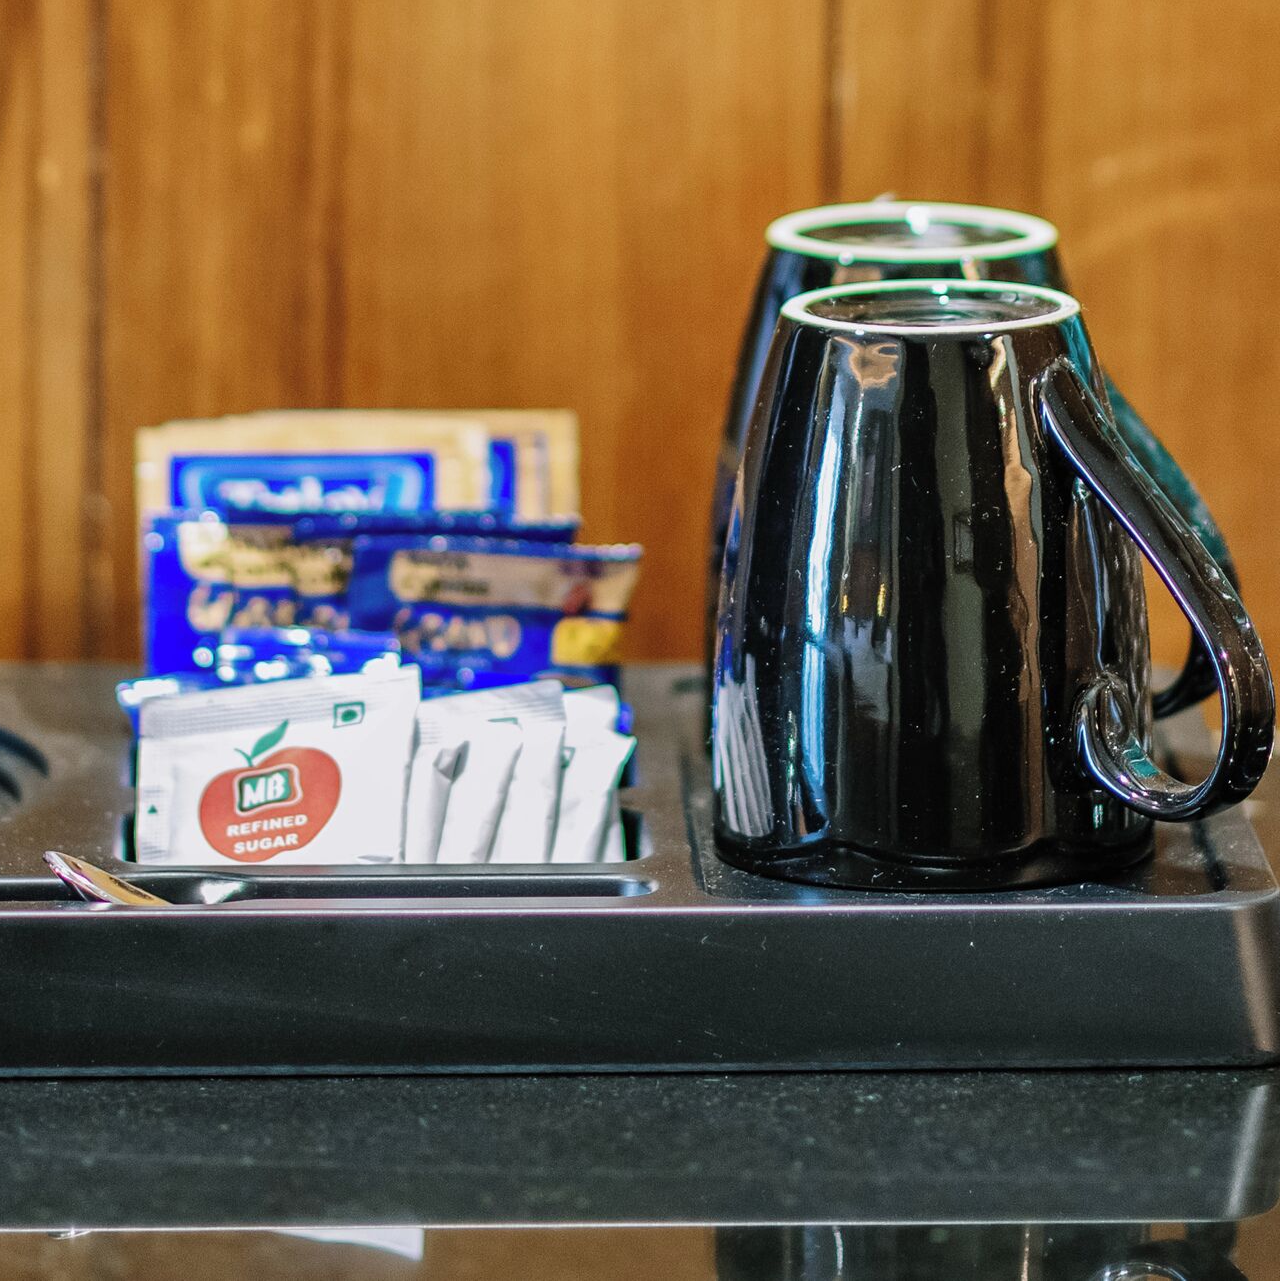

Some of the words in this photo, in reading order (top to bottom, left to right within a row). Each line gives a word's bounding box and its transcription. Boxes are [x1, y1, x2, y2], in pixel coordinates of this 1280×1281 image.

[242, 772, 286, 809] MB
[226, 814, 308, 837] REFINED
[233, 833, 299, 855] SUGAR
